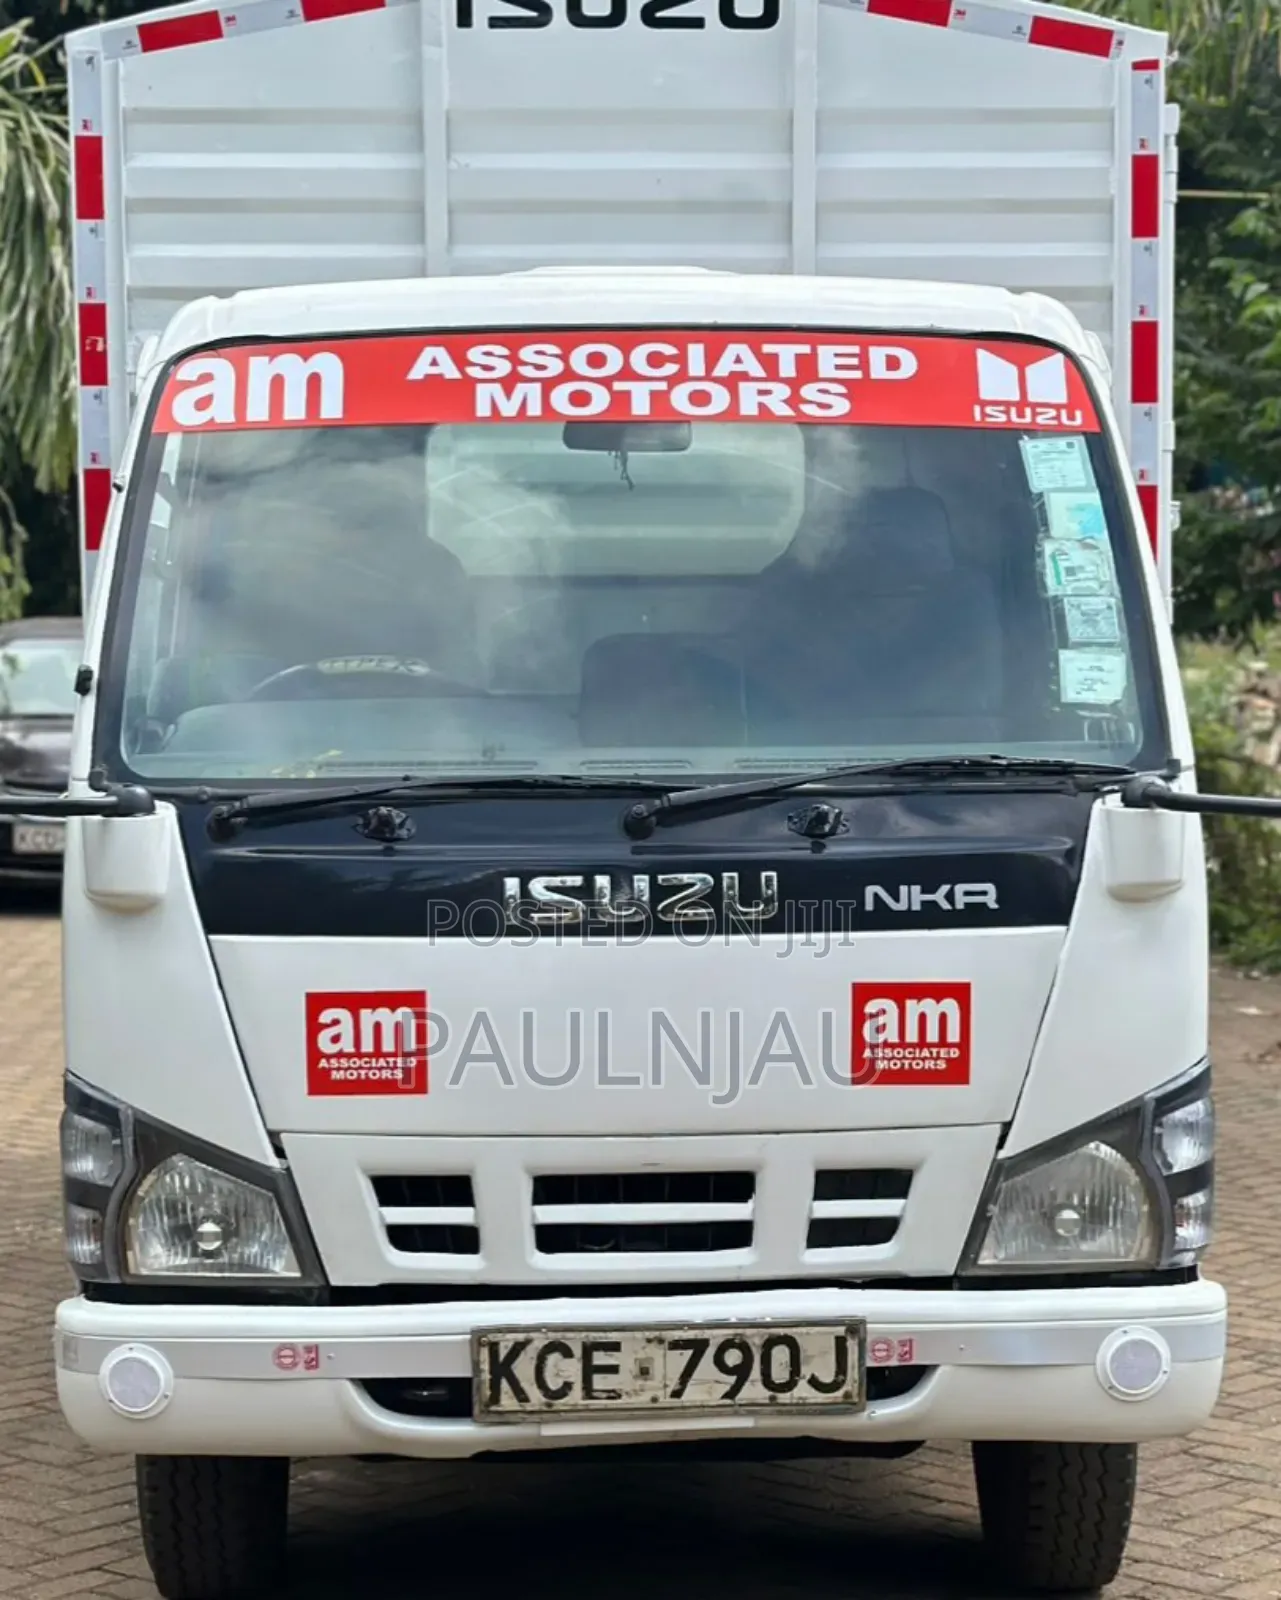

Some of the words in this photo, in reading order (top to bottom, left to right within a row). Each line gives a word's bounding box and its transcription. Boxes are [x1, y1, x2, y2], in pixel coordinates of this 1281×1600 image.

[406, 343, 918, 380] ASSOCIATED
[171, 351, 344, 426] am
[474, 381, 851, 418] MOTORS
[973, 404, 1083, 426] ISUZU
[503, 871, 778, 925] ISUZU
[864, 883, 999, 911] NKR
[317, 1007, 416, 1054] am
[861, 998, 961, 1043] am
[317, 1057, 417, 1069] ASSOCIATED
[862, 1047, 961, 1059] ASSOCIATED
[875, 1059, 948, 1071] MOTORS
[330, 1068, 404, 1081] MOTORS
[487, 1340, 623, 1404] KCE
[666, 1333, 850, 1401] 790J
